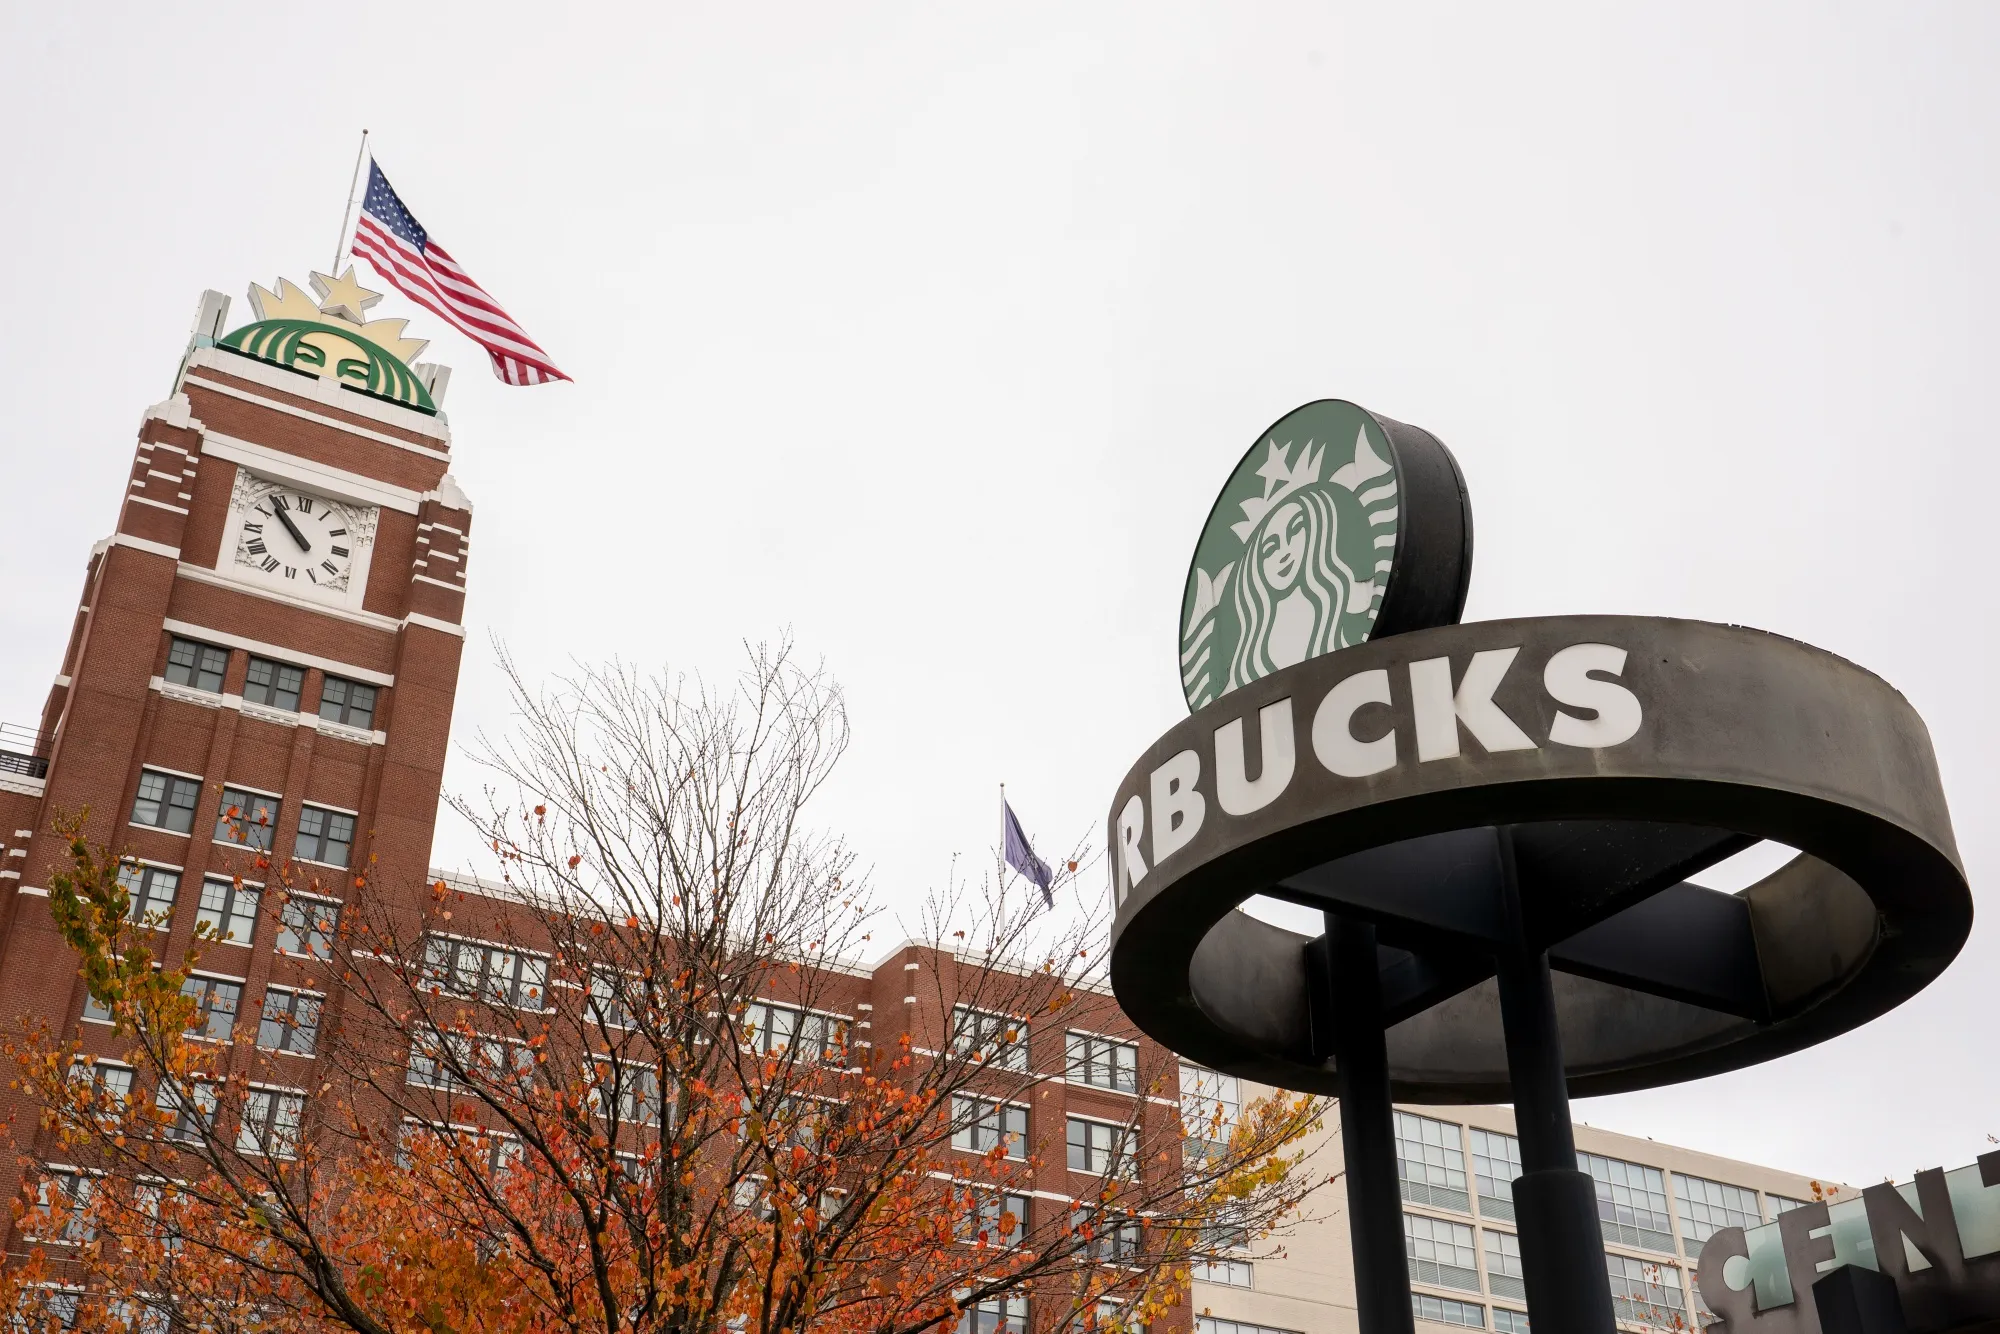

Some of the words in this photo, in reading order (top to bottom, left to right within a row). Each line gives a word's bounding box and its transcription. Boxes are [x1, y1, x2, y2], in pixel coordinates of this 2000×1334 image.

[254, 503, 273, 520] X
[296, 496, 314, 514] XII
[318, 510, 331, 522] I
[244, 520, 263, 535] IX
[329, 528, 347, 538] II
[245, 537, 268, 555] VIII
[331, 545, 349, 558] III
[260, 554, 281, 573] VII
[321, 559, 339, 576] IV
[285, 565, 297, 580] VI
[306, 568, 317, 583] V
[1109, 643, 1642, 925] RBUCKS
